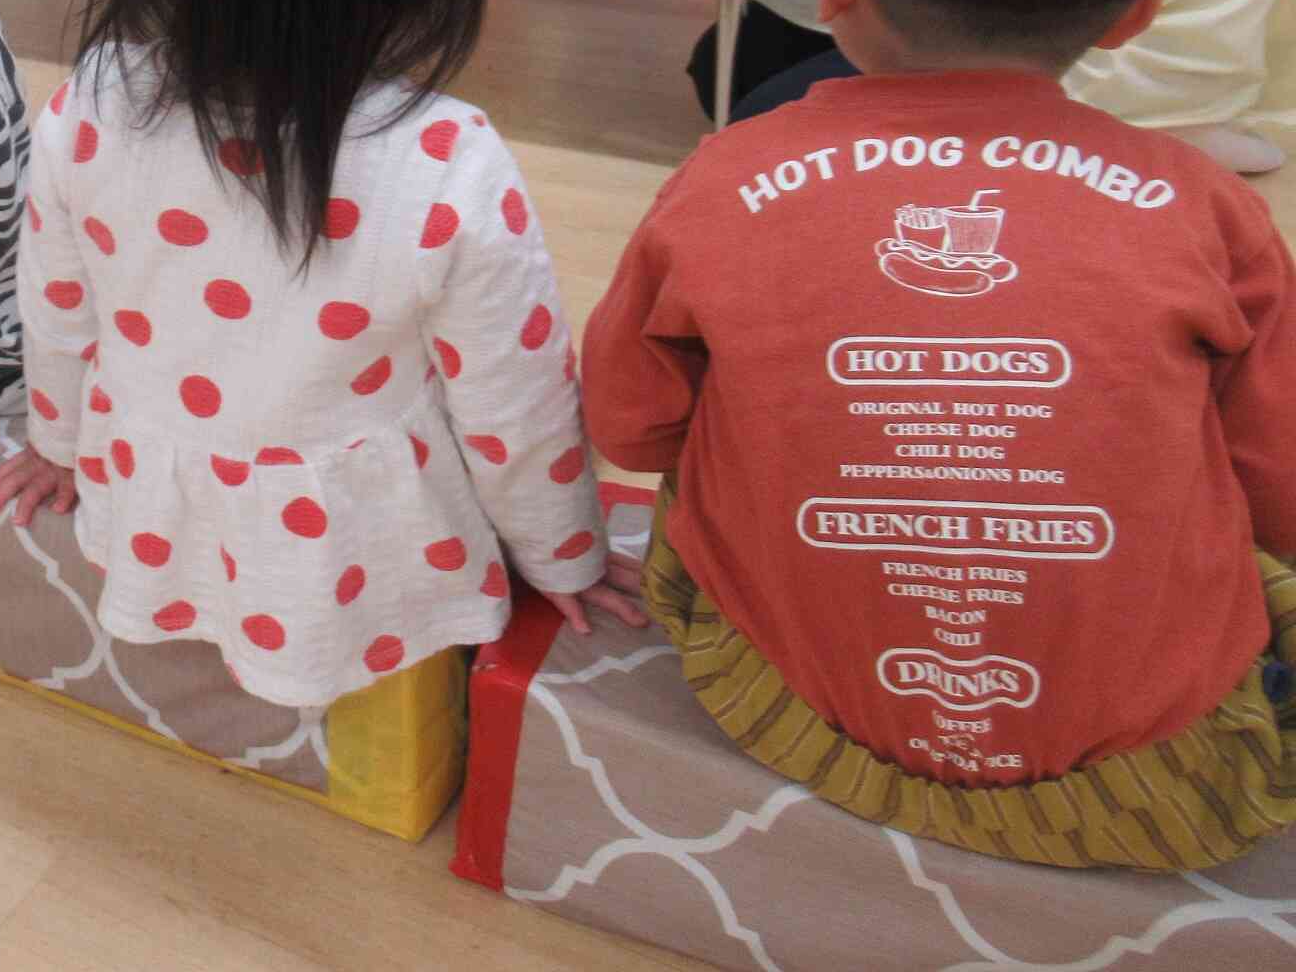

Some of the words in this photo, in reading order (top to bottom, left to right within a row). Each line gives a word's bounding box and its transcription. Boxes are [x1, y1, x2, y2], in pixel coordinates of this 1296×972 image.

[739, 148, 837, 213] HOT
[854, 136, 963, 171] DOG
[981, 136, 1175, 209] COMBO
[848, 350, 928, 372] HOT
[941, 351, 1049, 374] DOGS
[849, 402, 946, 414] ORIGINAL
[952, 403, 998, 416] HOT
[1005, 404, 1052, 418] DOG
[884, 423, 962, 436] CHEESE
[968, 424, 1016, 438] DOG
[896, 445, 951, 457] CHILI
[957, 446, 1005, 459] DOG
[1018, 469, 1064, 483] DOG
[815, 512, 969, 540] FRENCH
[982, 517, 1095, 546] FRIES
[882, 562, 963, 581] FRENCH
[968, 567, 1027, 583] FRIES
[888, 584, 961, 603] CHEESE
[966, 589, 1024, 604] FRIES
[925, 606, 986, 624] BACON
[896, 661, 1020, 696] DRINKS
